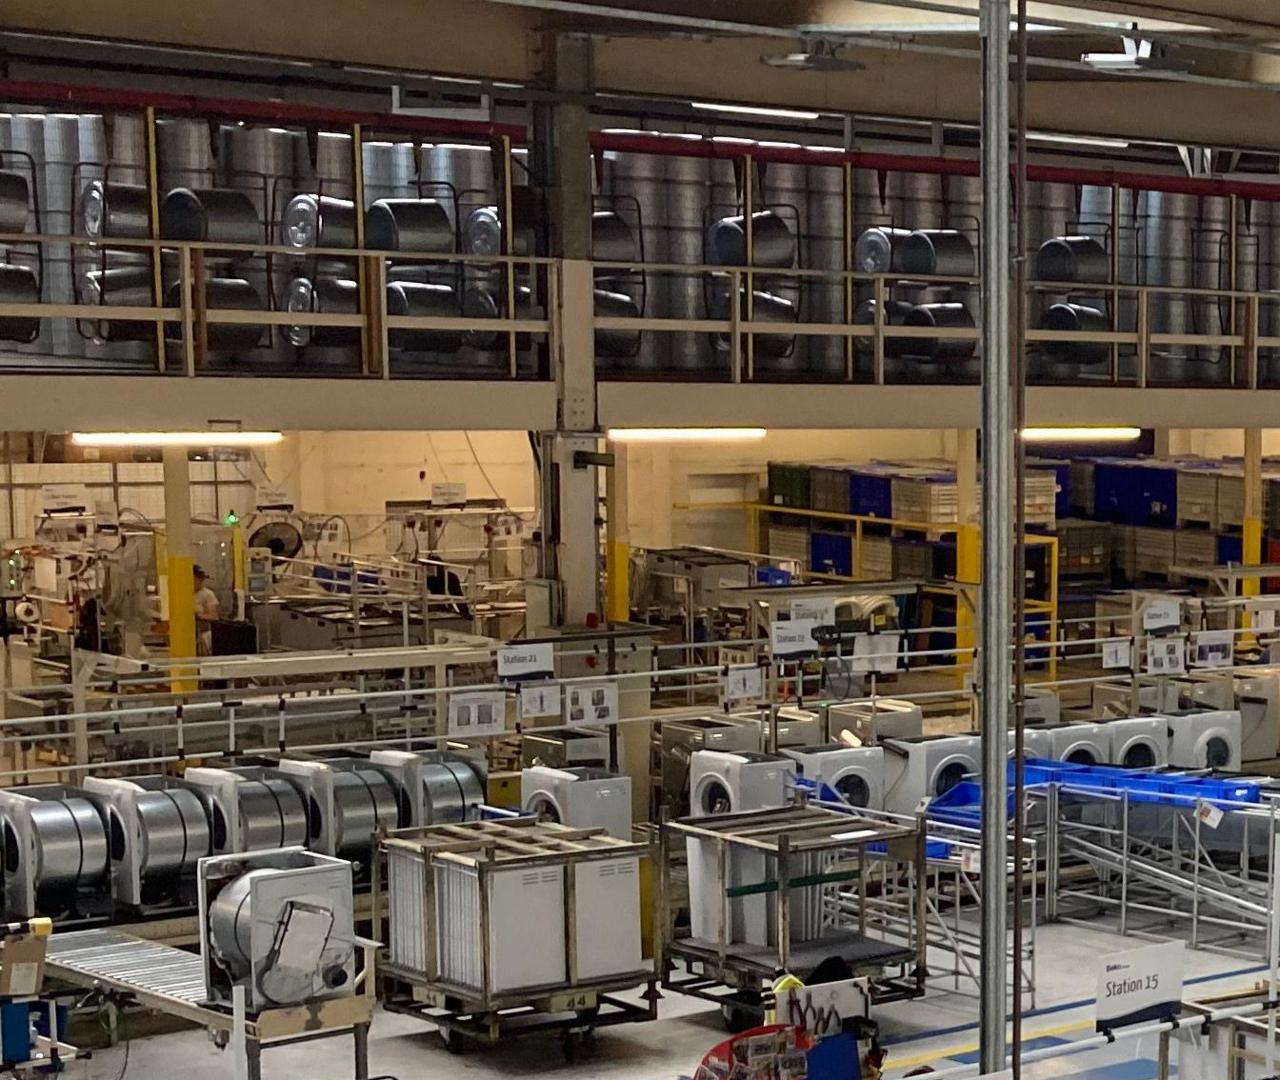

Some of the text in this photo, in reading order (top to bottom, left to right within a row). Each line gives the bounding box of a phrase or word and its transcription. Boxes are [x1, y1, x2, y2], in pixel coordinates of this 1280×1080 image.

[503, 655, 527, 665] Station
[1106, 974, 1159, 998] Station 15
